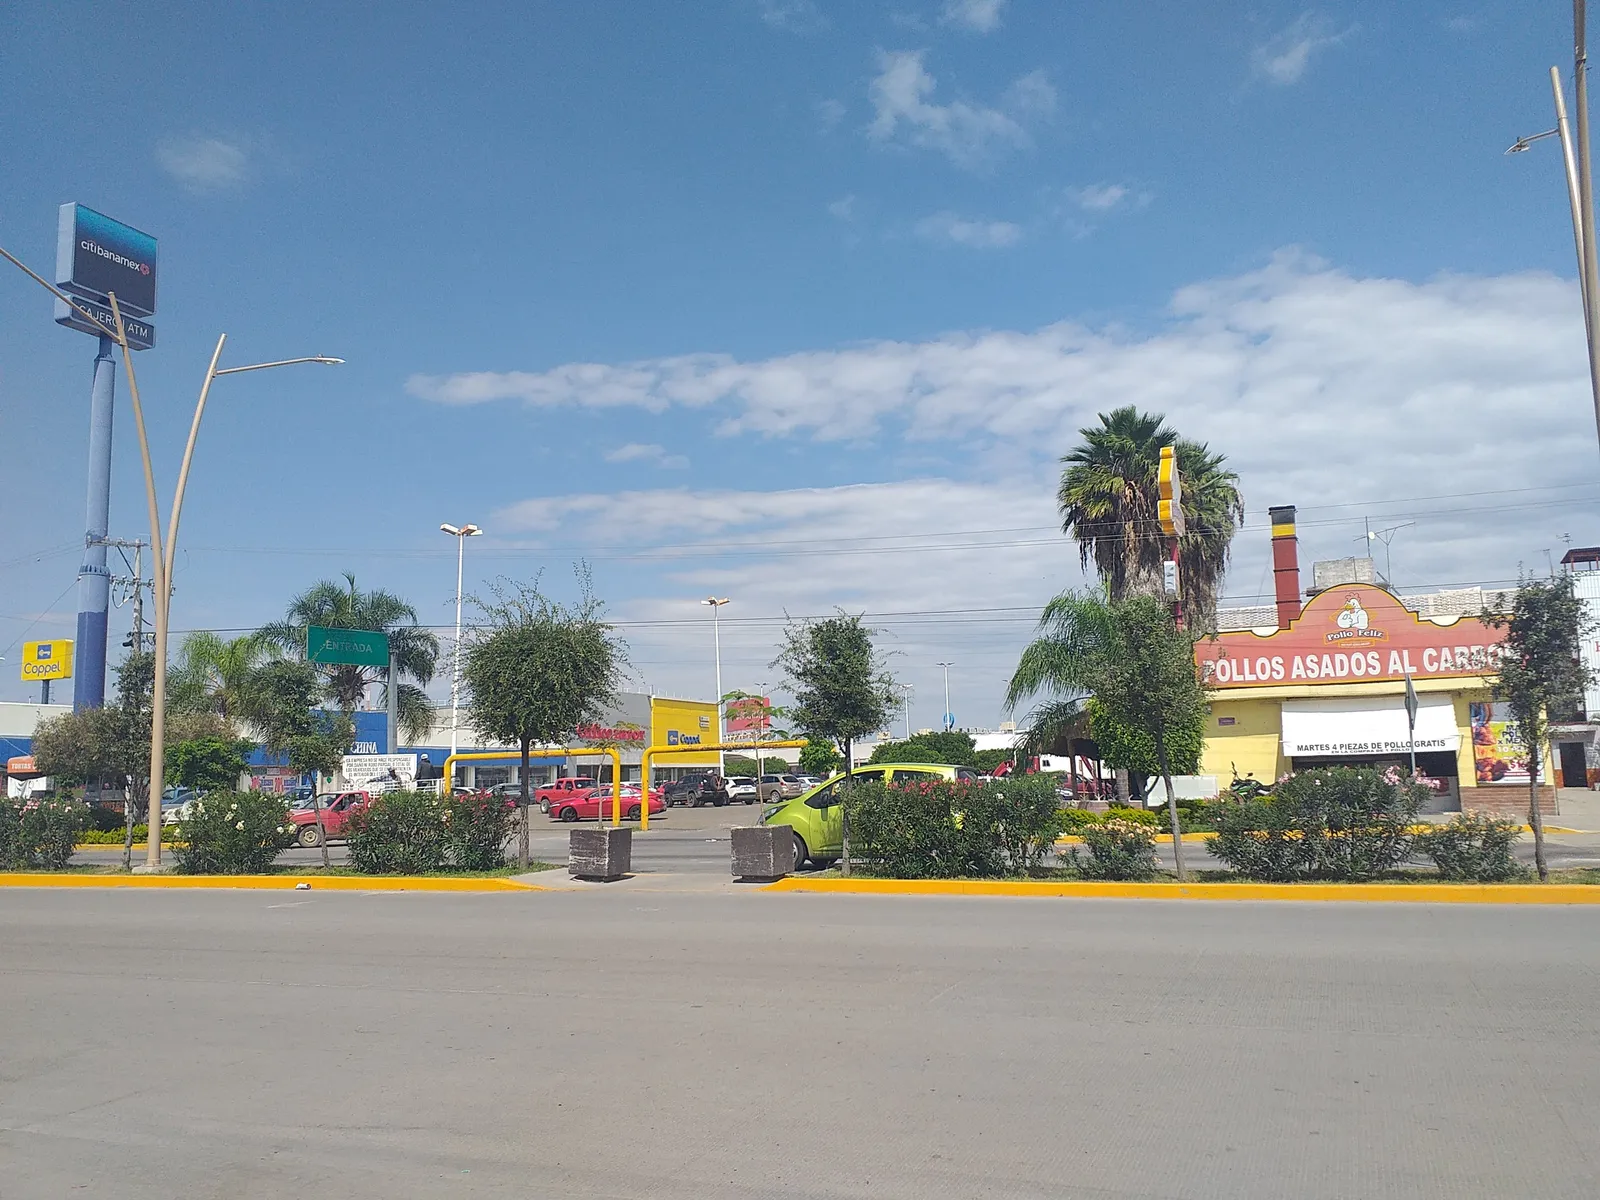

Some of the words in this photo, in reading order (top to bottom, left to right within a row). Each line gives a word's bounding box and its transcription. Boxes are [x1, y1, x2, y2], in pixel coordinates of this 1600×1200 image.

[80, 240, 140, 272] citibanamex
[127, 323, 148, 338] ATM
[1327, 630, 1354, 641] Pollo
[1358, 629, 1384, 638] Feliz
[325, 640, 373, 653] ENTRADA
[23, 661, 61, 677] Coppel
[1291, 651, 1381, 679] ASADOS
[1388, 649, 1418, 674] AL
[1297, 744, 1330, 752] MARTES
[1332, 743, 1337, 751] 4
[1340, 742, 1369, 750] PIEZAS
[1384, 741, 1411, 749] POLLO
[1414, 740, 1446, 748] GRATIS
